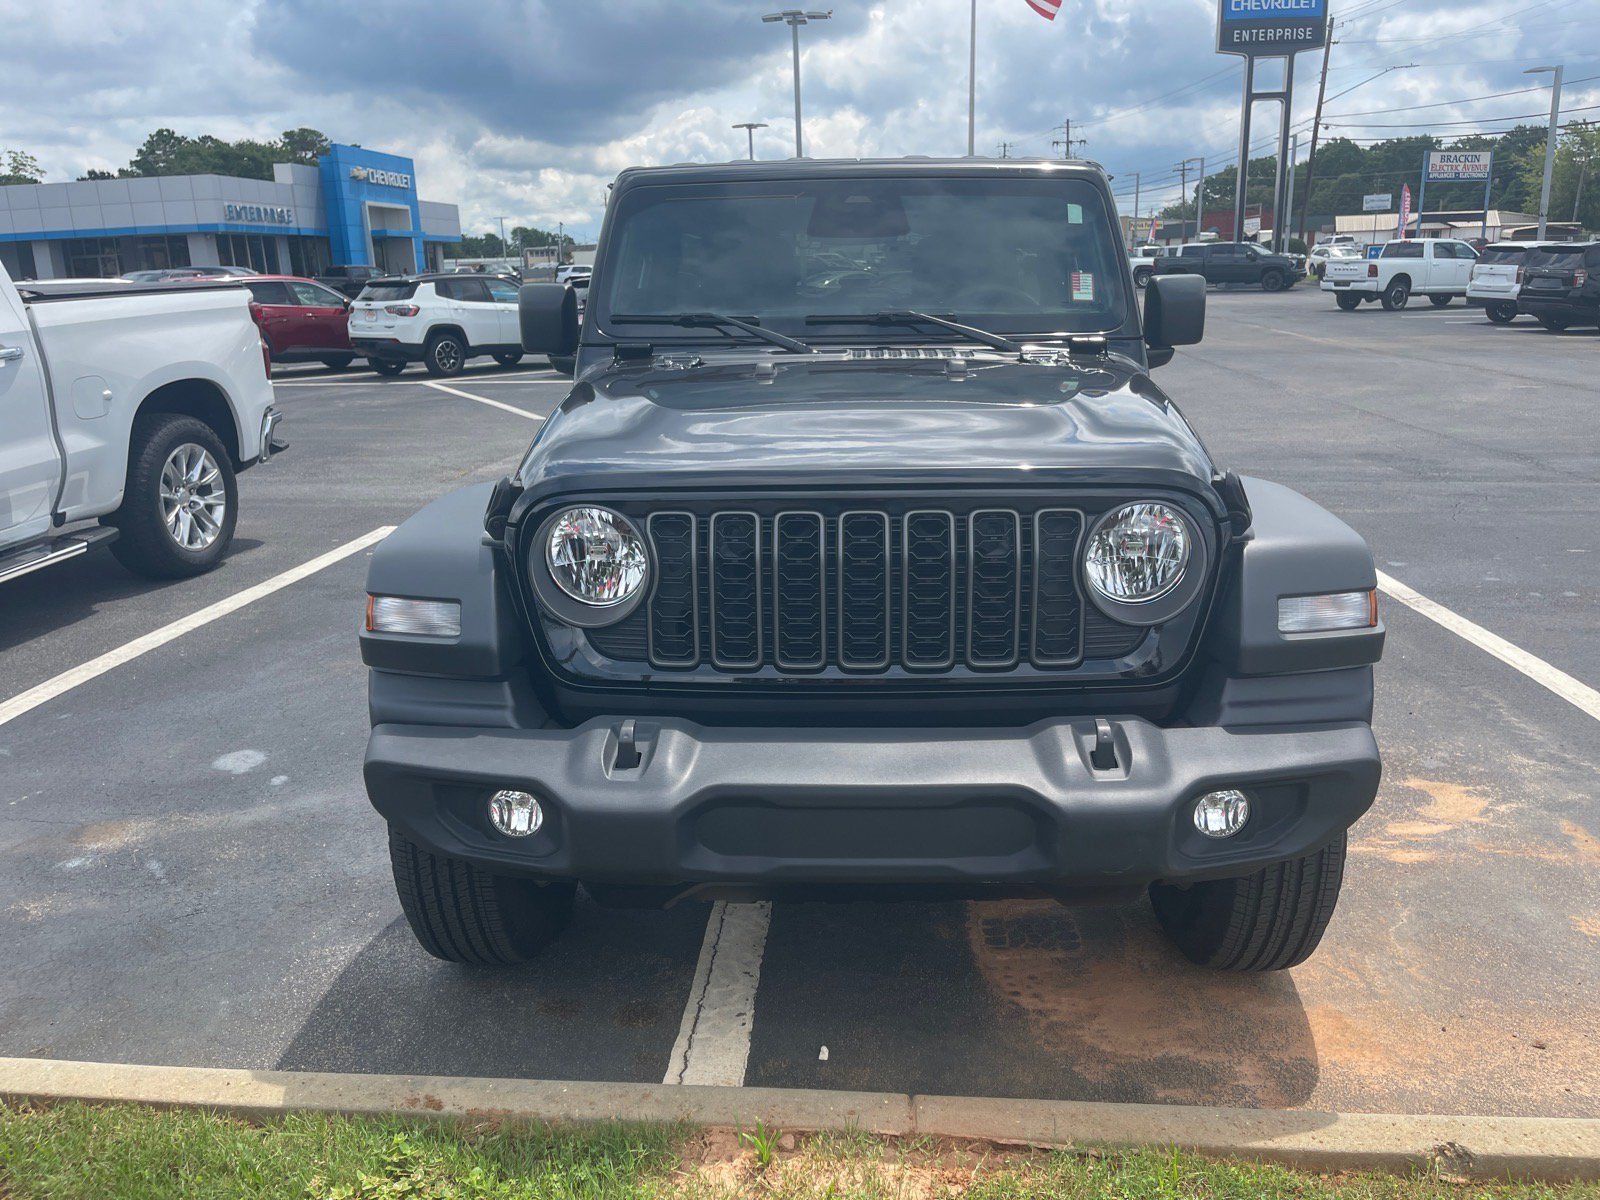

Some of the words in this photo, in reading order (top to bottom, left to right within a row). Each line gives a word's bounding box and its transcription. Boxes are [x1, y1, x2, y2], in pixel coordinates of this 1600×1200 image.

[1231, 0, 1316, 11] CHEVROLET
[1233, 27, 1313, 42] ENTERPRISE
[1440, 154, 1480, 163] BRACKIN
[1461, 163, 1488, 171] AVENUE
[368, 168, 411, 189] CHEVROLET
[225, 203, 293, 225] ENTERPRISE
